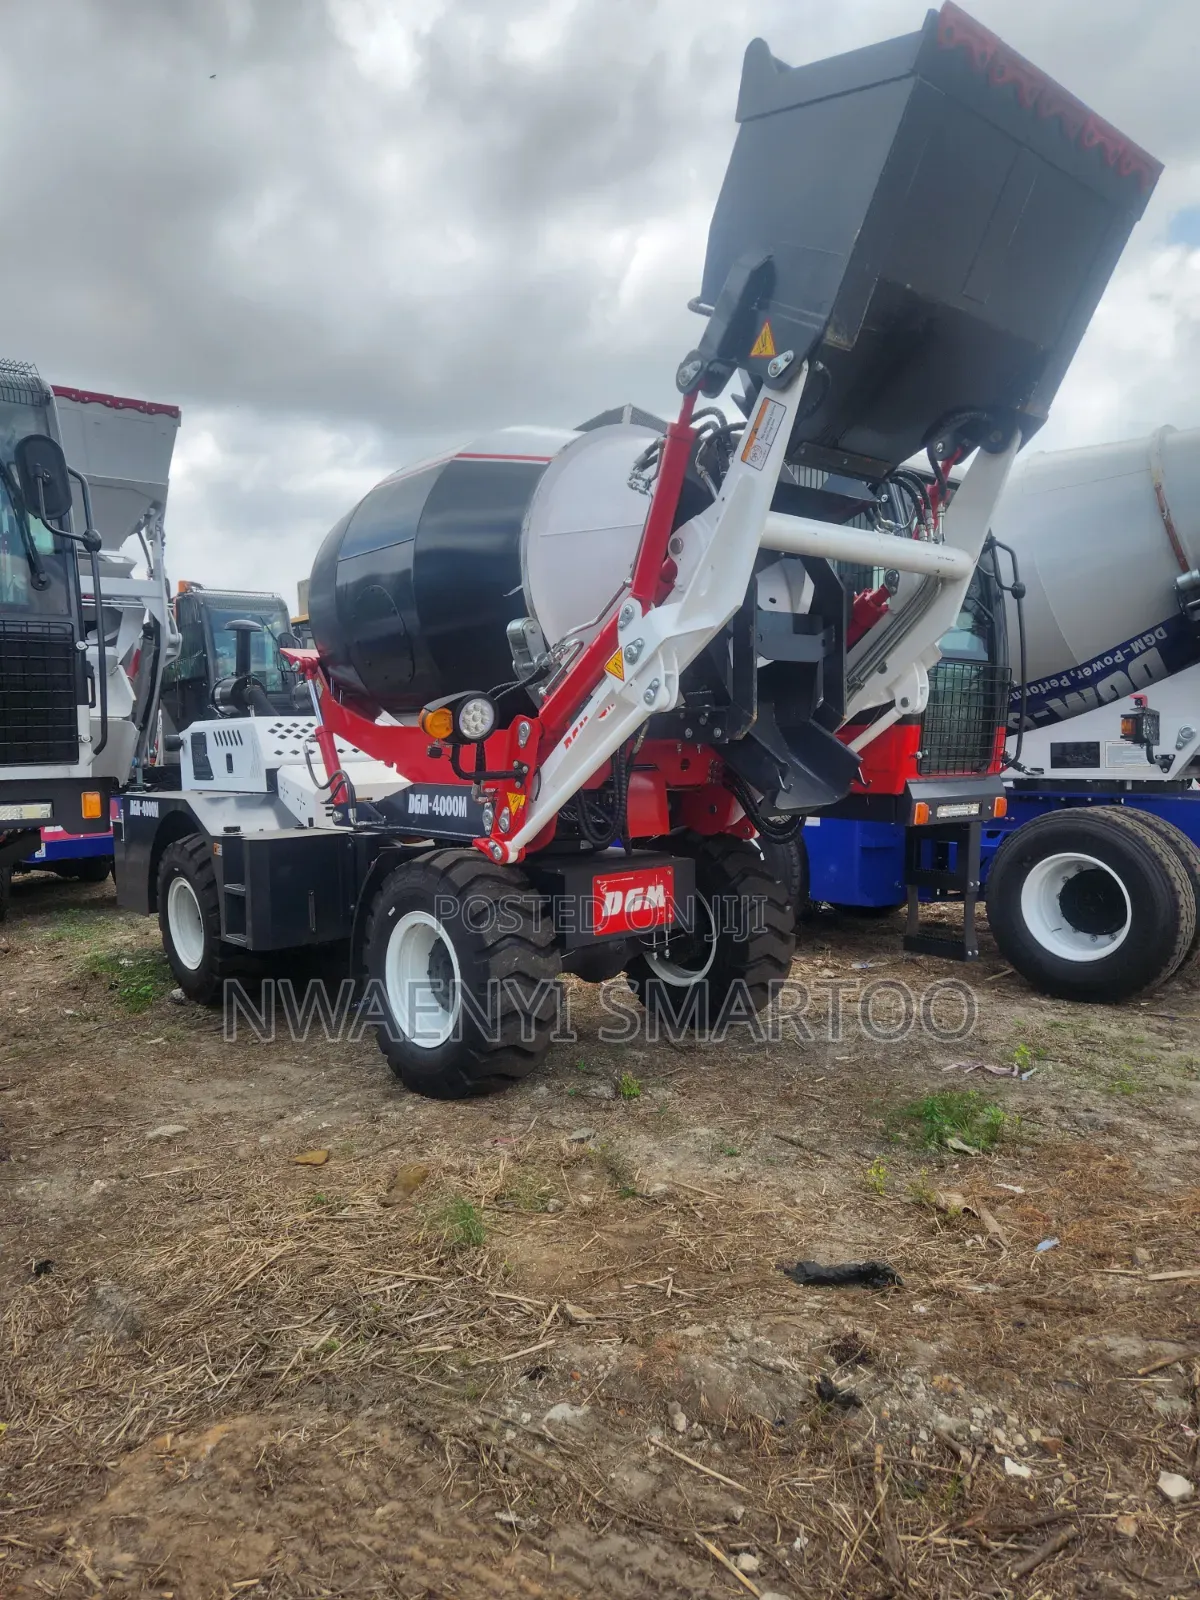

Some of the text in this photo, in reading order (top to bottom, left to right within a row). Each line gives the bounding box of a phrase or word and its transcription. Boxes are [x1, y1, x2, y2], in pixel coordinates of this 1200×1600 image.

[1071, 626, 1168, 680] DGM-Power,
[407, 793, 468, 818] DGM-4000M
[601, 884, 666, 917] DGM
